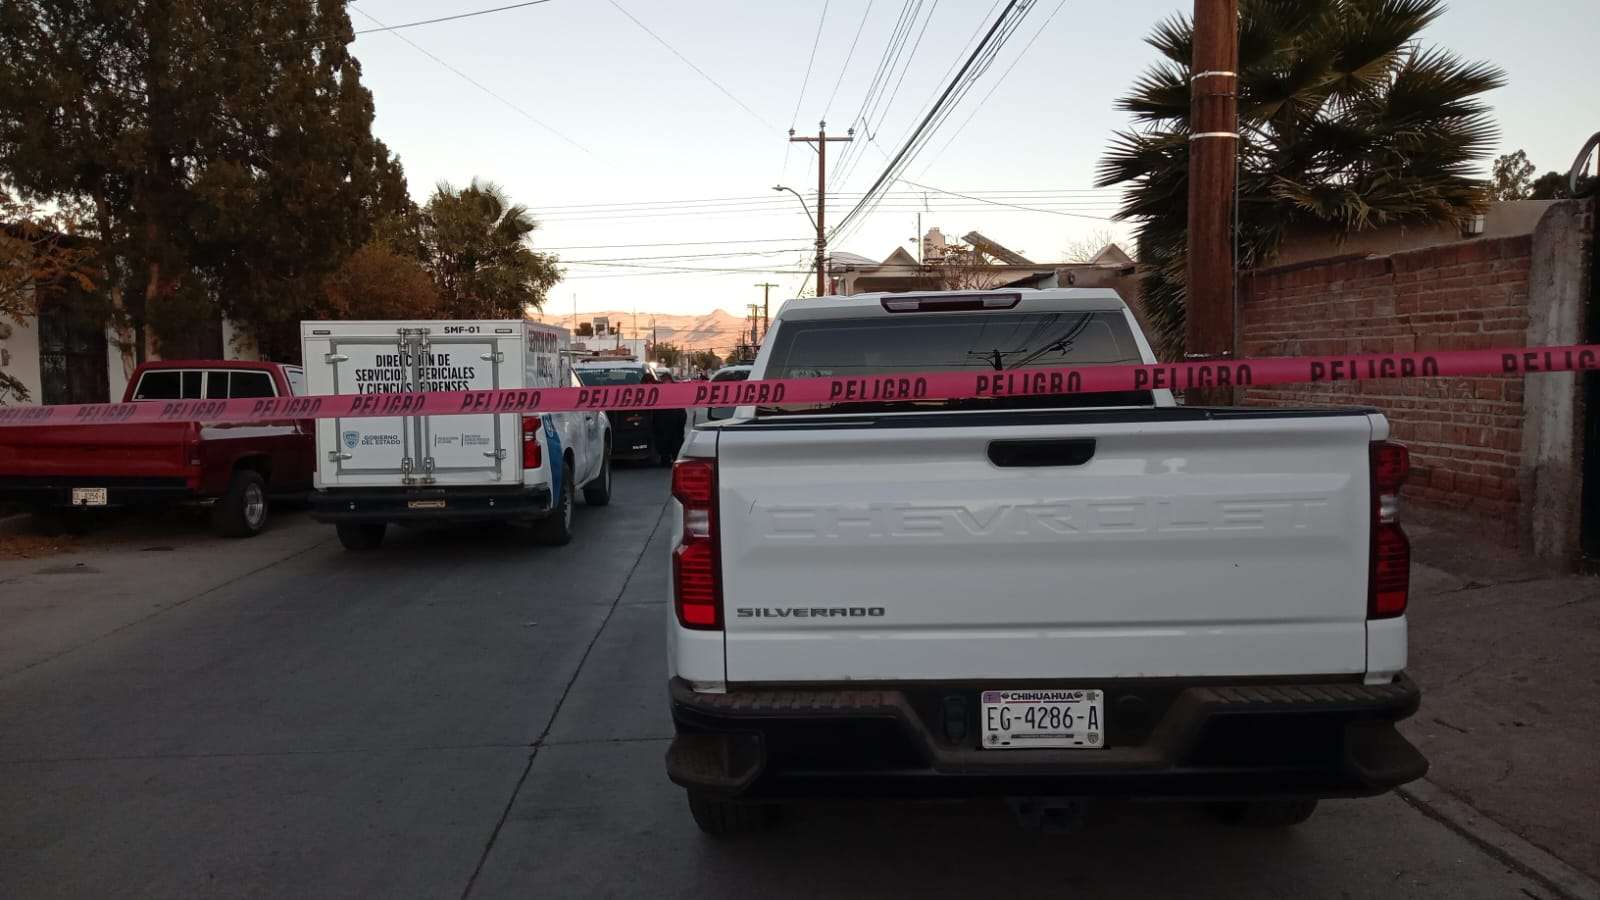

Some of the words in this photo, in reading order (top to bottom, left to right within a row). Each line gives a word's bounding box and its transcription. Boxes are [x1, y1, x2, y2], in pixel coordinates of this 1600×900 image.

[444, 326, 480, 334] SMF-01
[437, 354, 451, 366] DE
[419, 367, 475, 380] PERICIALES
[161, 401, 226, 420] PELIGRO
[251, 398, 322, 416] PELIGRO
[349, 395, 425, 413] PELIGRO
[460, 391, 541, 410] PELIGRO
[576, 387, 660, 408] PELIGRO
[693, 383, 785, 404] PELIGRO
[831, 377, 927, 399] PELIGRO
[976, 371, 1081, 395] PELIGRO
[1134, 364, 1251, 390] PELIGRO
[1310, 356, 1438, 382] PELIGRO
[358, 383, 364, 394] Y
[763, 498, 1327, 538] CHEVROLET
[737, 607, 885, 617] SILVERADO
[987, 706, 1098, 731] EG-4286-A
